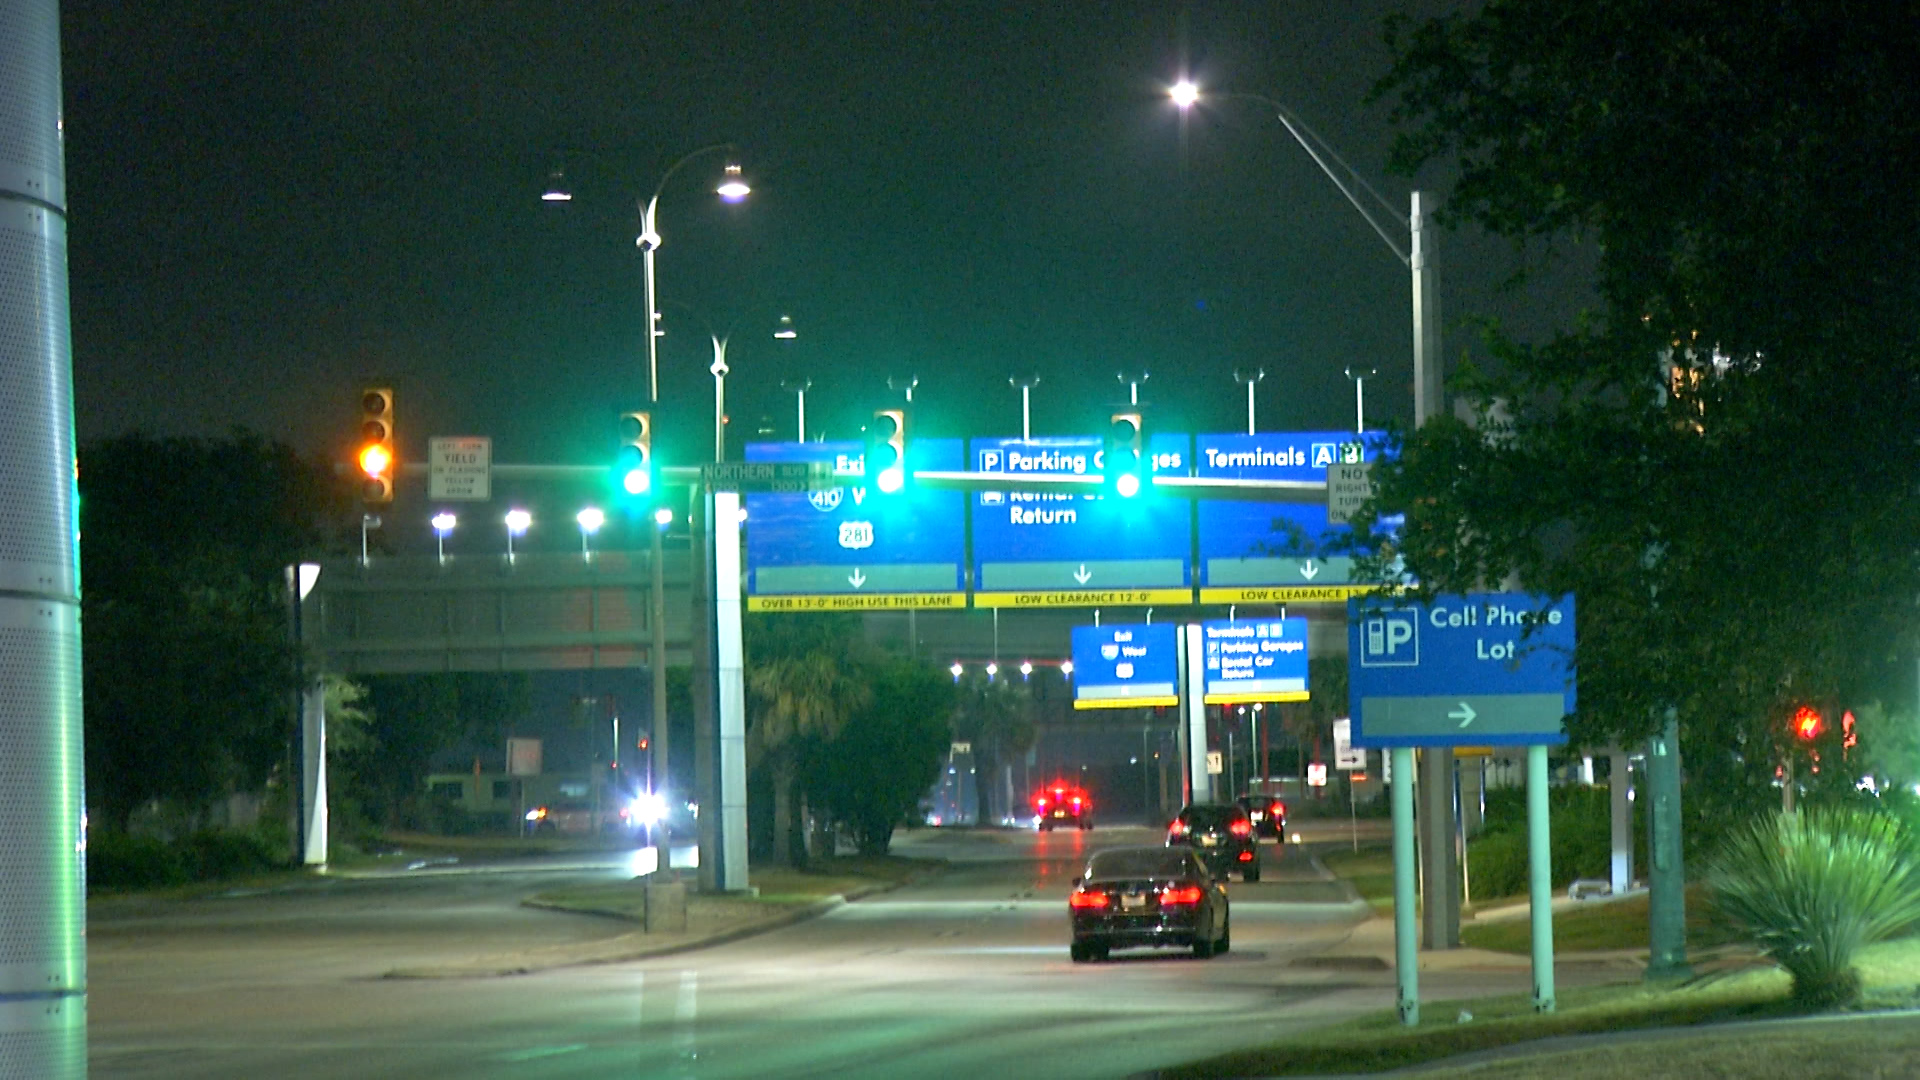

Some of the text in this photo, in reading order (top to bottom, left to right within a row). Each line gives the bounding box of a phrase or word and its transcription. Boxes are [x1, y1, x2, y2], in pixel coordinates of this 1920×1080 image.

[444, 453, 476, 464] YIELD
[1008, 450, 1086, 474] Parking
[1205, 446, 1305, 467] Terminals
[1315, 446, 1333, 465] A
[703, 464, 774, 480] NORTHERN
[1341, 467, 1363, 480] NO
[1335, 483, 1368, 493] RIGHT
[813, 490, 839, 507] 410
[1010, 506, 1077, 524] Return
[844, 528, 868, 542] 281
[761, 599, 793, 609] OVER
[833, 598, 864, 608] HIGH
[868, 597, 891, 607] USE
[894, 596, 919, 607] THIS
[923, 595, 952, 606] LANE
[1015, 594, 1042, 604] LOW
[1047, 593, 1115, 604] CLEARANCE
[1241, 591, 1268, 601] LOW
[1273, 589, 1342, 600] CLEARANCE
[1430, 605, 1477, 628] Cell
[1477, 639, 1515, 660] Lot
